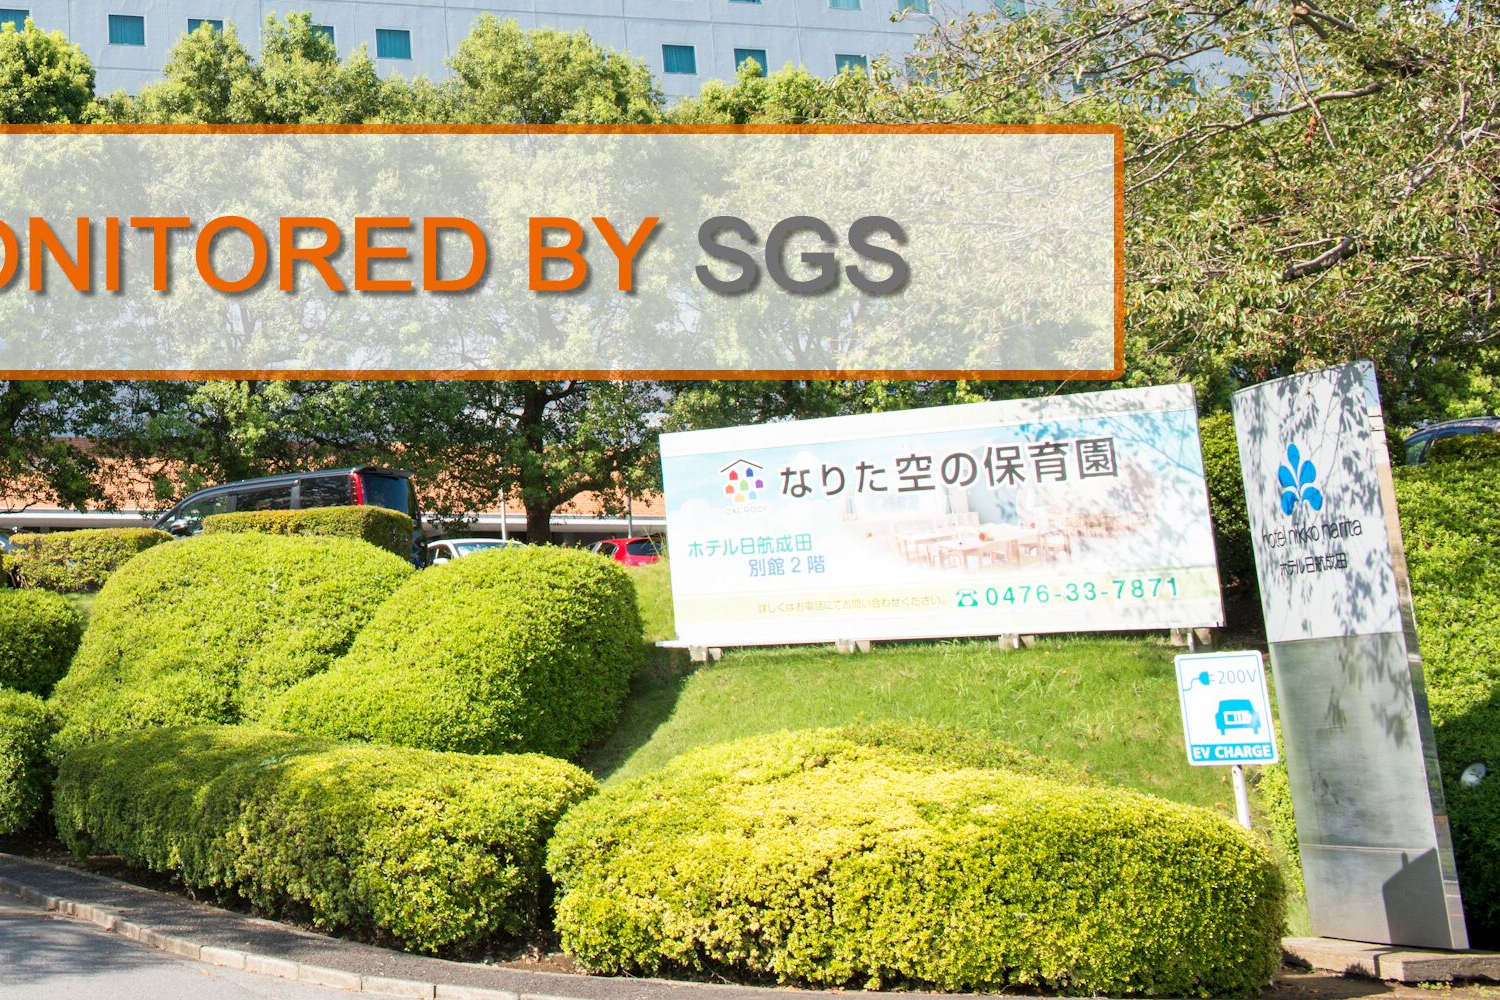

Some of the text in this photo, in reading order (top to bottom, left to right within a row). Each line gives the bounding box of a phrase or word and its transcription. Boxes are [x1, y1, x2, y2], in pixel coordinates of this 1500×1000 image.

[780, 437, 1118, 498] なりた空の保育園
[1262, 516, 1362, 548] hotel nikko narita
[688, 533, 813, 558] ホテル日航成田
[1280, 552, 1347, 576] ホテル日航成田
[985, 576, 1178, 606] 0476-33-7871
[1218, 669, 1256, 684] 200V
[1192, 745, 1271, 760] EV CHARGE
